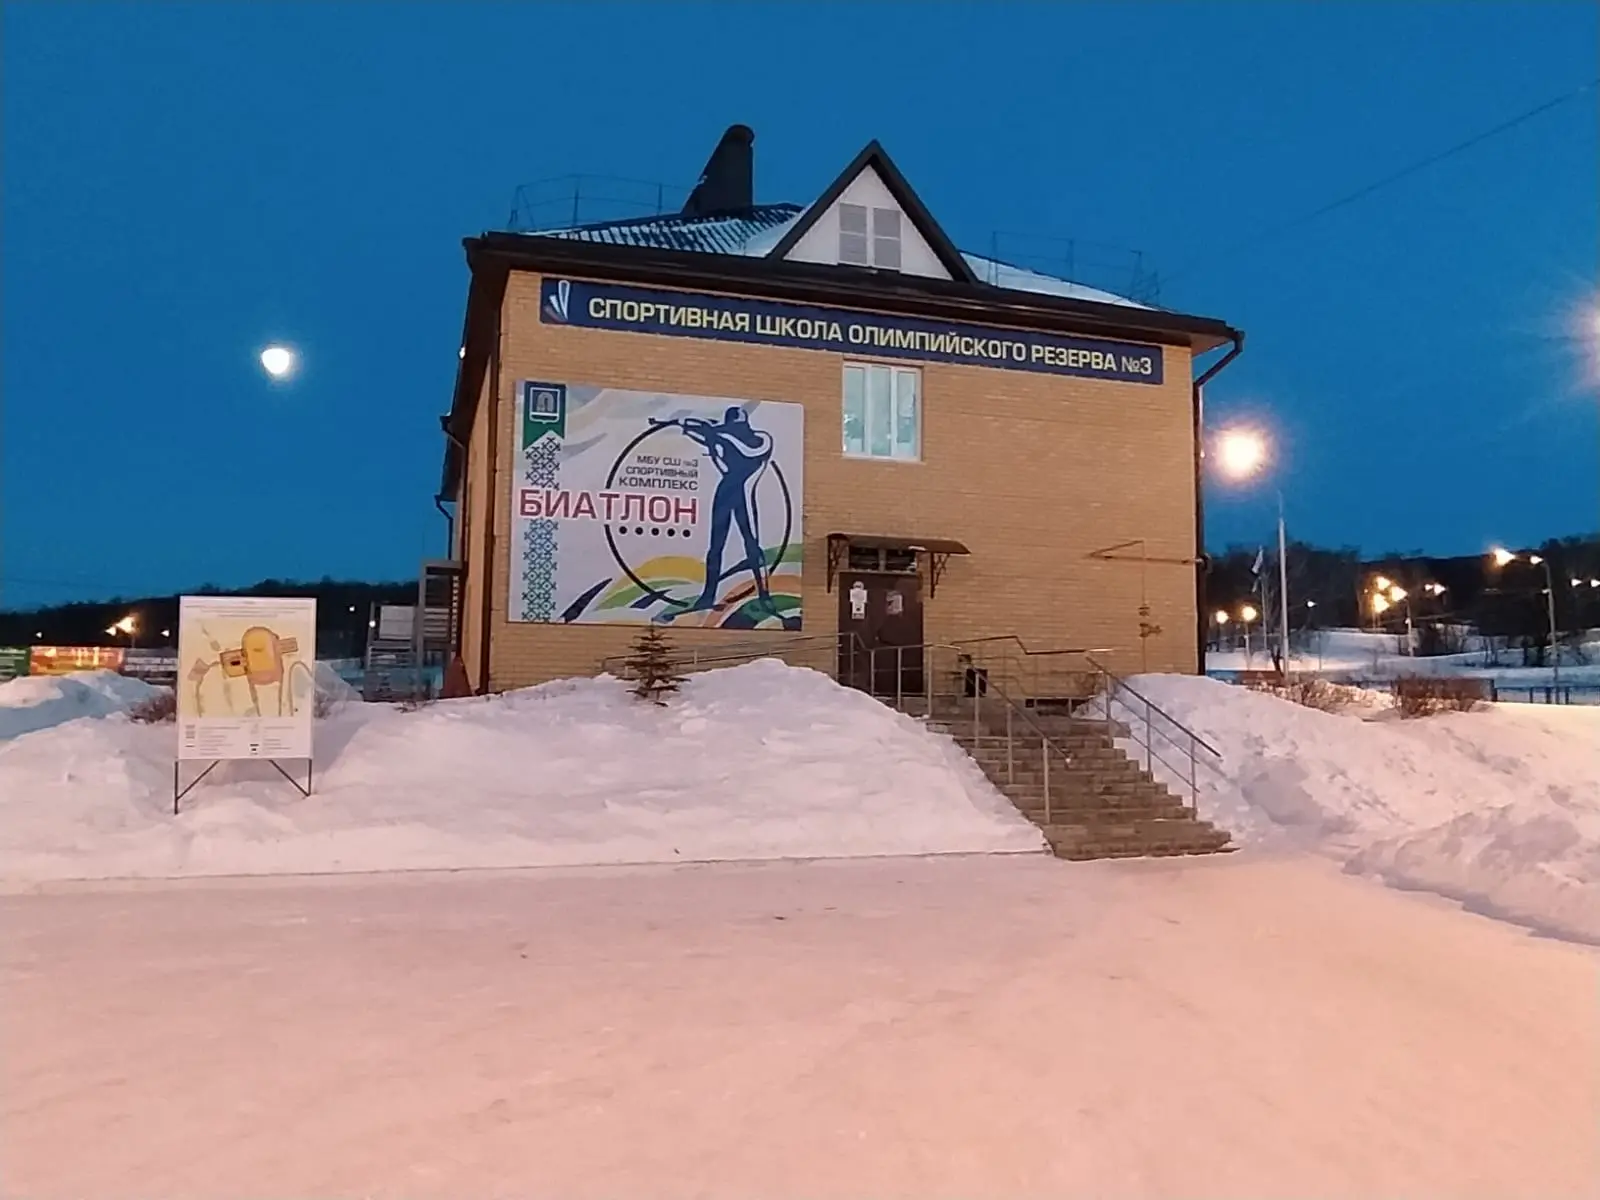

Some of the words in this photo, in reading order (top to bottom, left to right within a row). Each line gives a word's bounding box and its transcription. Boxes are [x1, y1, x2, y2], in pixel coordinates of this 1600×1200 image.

[588, 296, 750, 333] СПОРТИВНАЯ
[755, 313, 844, 343] ШКОЛА
[847, 323, 1027, 362] ОЛИМПИЙСКОГО
[1030, 345, 1118, 372] РЕЗЕРВА
[1120, 355, 1153, 375] №3
[636, 455, 660, 465] МБУ
[662, 457, 681, 466] СШ
[625, 466, 698, 478] СПОРТИВНЫЙ
[618, 476, 698, 490] КОМПЛЕКС
[519, 488, 698, 525] БИАТЛОН
